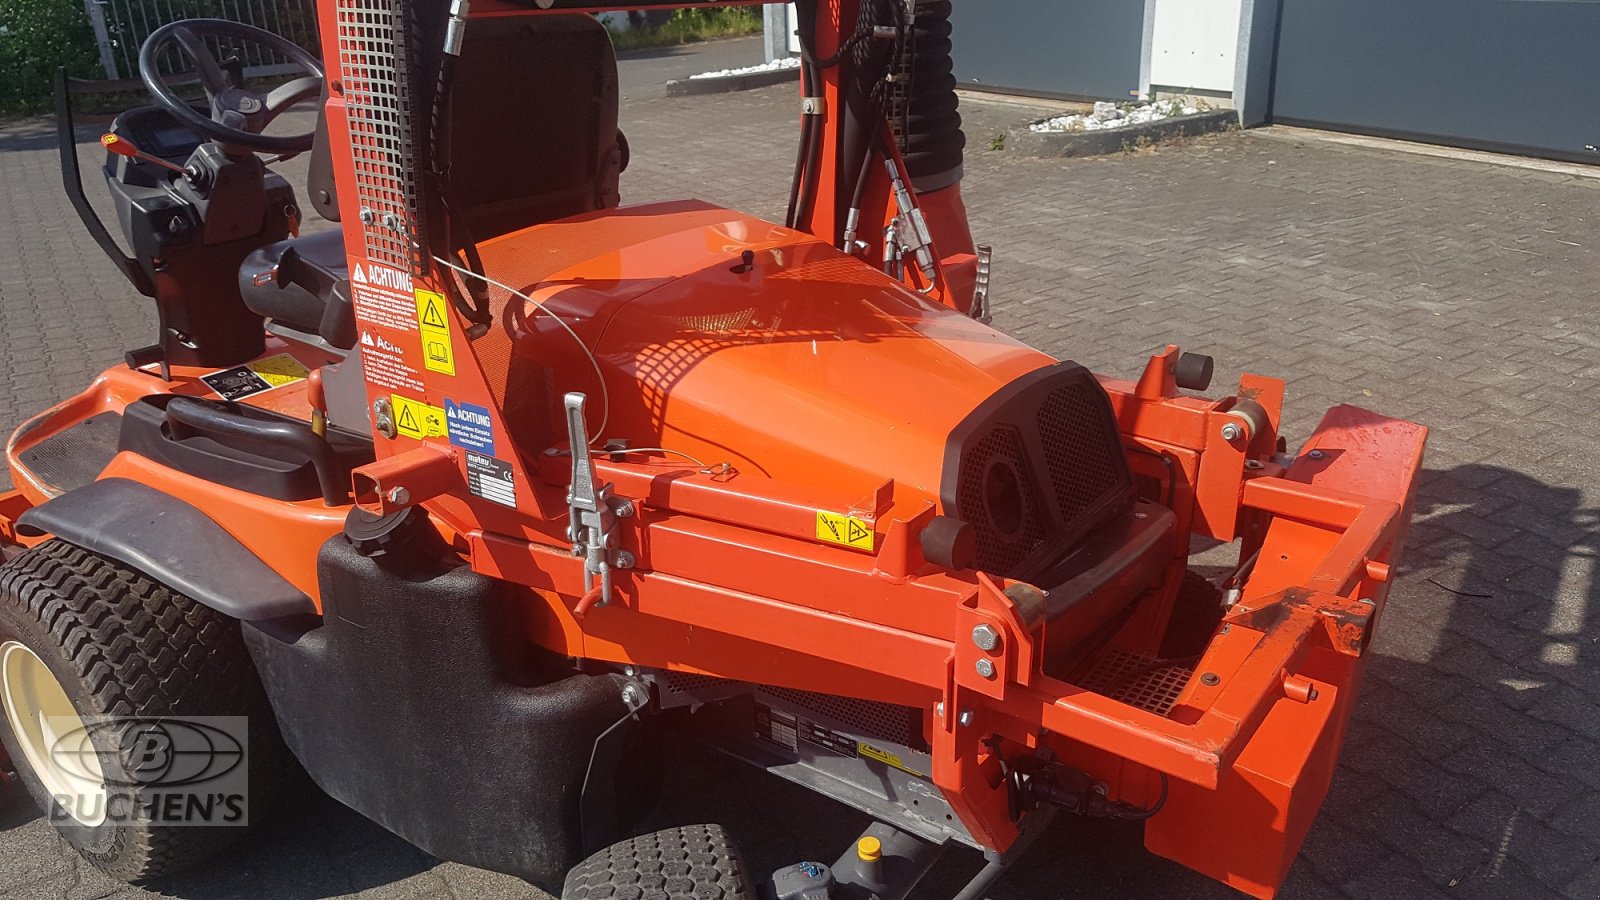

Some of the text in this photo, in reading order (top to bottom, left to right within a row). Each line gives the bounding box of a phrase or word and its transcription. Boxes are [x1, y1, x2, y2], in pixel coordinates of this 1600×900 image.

[369, 264, 413, 293] ACHTUNG
[457, 409, 490, 427] ACHTUNG
[467, 454, 490, 466] matev
